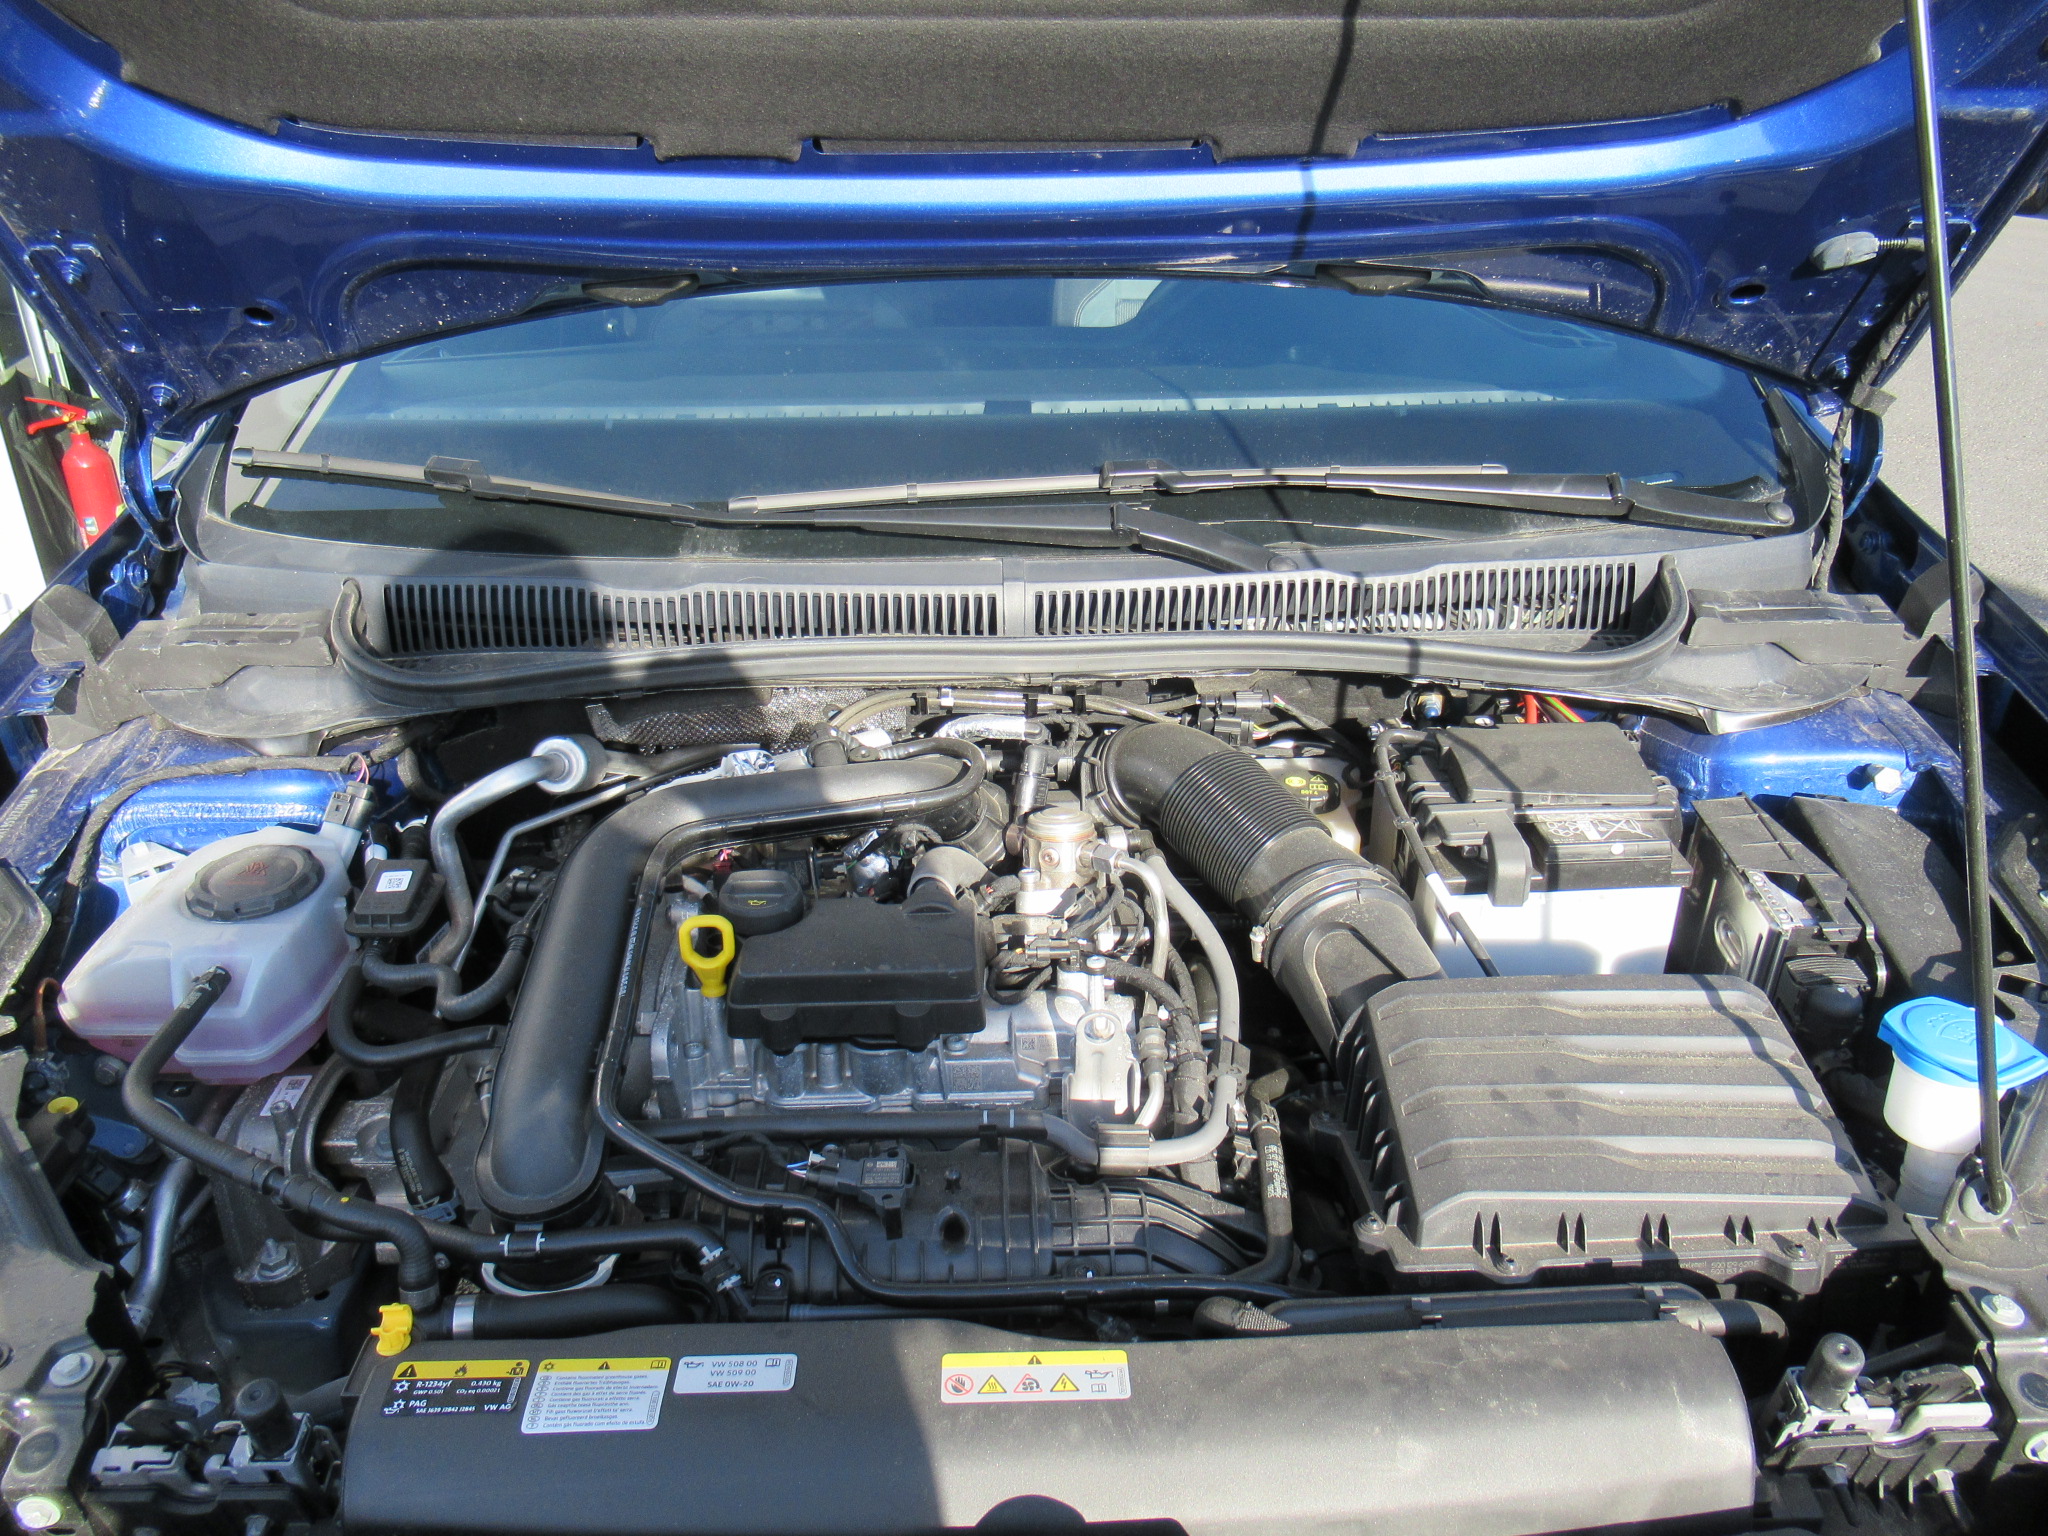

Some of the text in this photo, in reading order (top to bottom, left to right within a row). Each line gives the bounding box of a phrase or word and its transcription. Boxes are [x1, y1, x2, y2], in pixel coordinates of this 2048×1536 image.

[415, 1379, 453, 1388] R-1234yf
[492, 1379, 503, 1387] kg
[725, 1380, 754, 1388] 0W-20
[408, 1399, 428, 1408] PAG
